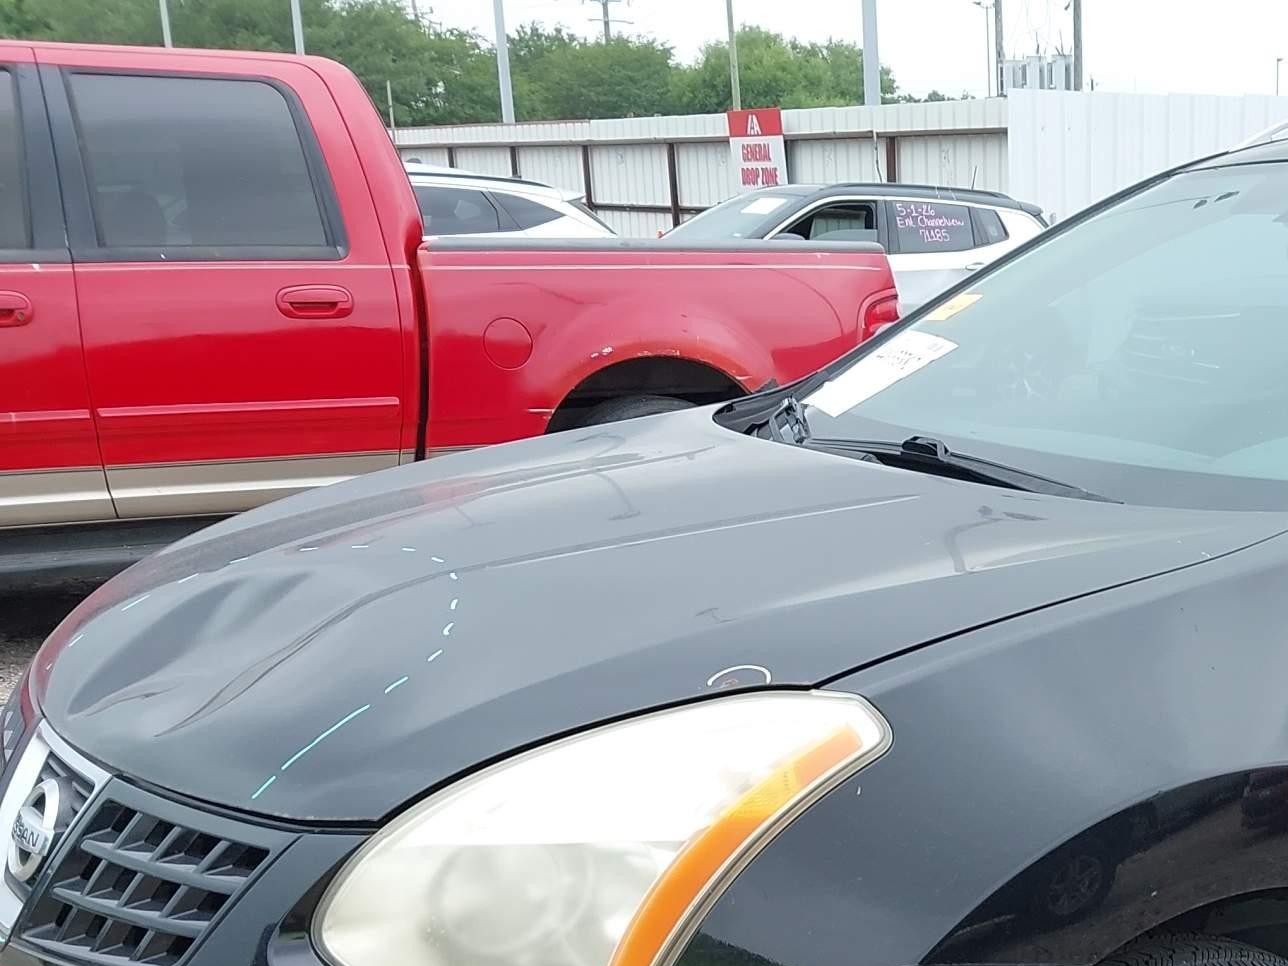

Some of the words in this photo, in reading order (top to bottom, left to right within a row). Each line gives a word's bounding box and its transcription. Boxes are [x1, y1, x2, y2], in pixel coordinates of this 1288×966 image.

[742, 143, 772, 162] GENERAL
[741, 167, 760, 186] DROP
[761, 167, 779, 186] ZONE
[896, 203, 936, 216] 5-1-26
